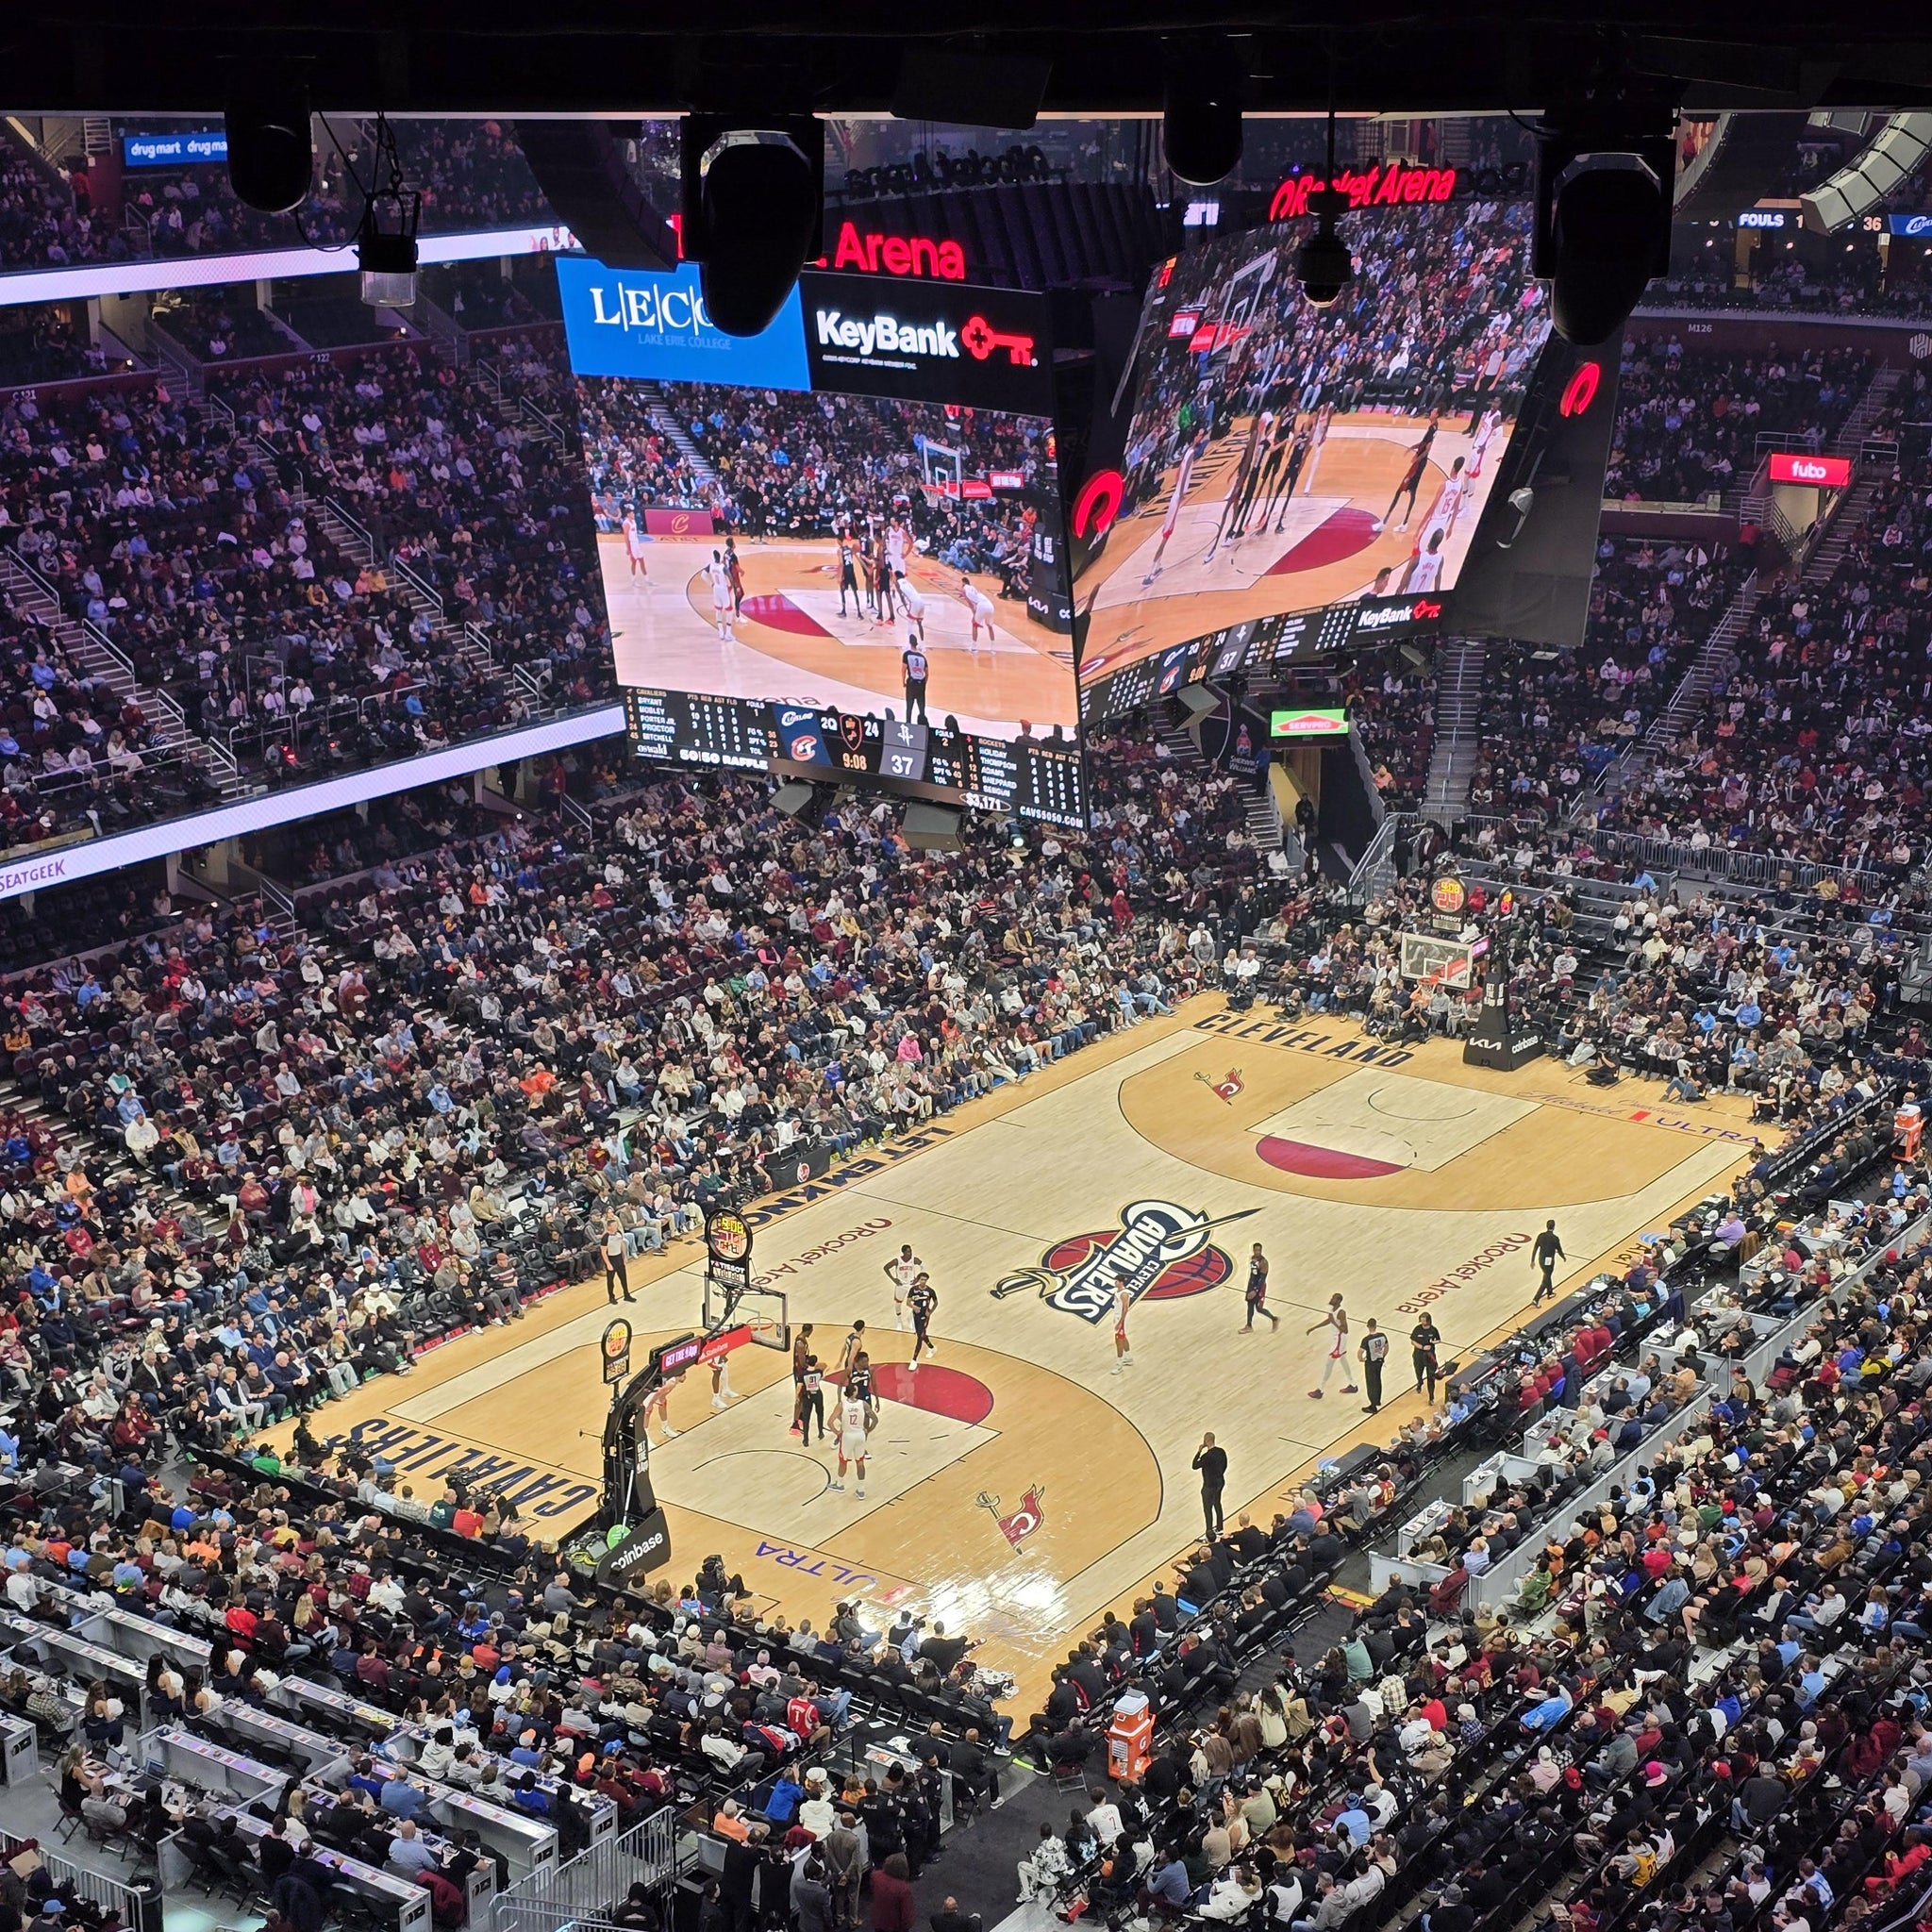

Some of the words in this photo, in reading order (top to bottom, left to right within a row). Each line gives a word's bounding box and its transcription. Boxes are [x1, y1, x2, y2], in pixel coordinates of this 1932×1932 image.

[131, 142, 156, 158] drug
[156, 142, 181, 155] mart
[188, 140, 211, 156] drug
[212, 141, 228, 152] ma
[1290, 165, 1380, 217] Rket
[1374, 163, 1457, 205] Arena
[1740, 213, 1784, 227] FOULS
[1863, 216, 1882, 231] 36
[834, 222, 965, 280] Arena
[638, 333, 661, 345] LAKE
[665, 335, 686, 347] ERIE
[688, 337, 731, 351] COLLEGE
[816, 309, 959, 358] KeyBank
[1791, 460, 1826, 478] fubo
[1358, 605, 1413, 628] KeyBank
[1220, 651, 1238, 670] 37
[864, 721, 879, 738] 24
[722, 755, 769, 771] RAFFLE
[841, 752, 867, 772] 9:08
[891, 754, 914, 775] 37
[965, 791, 1001, 811] $3,171
[1020, 805, 1084, 828] CAVS5050.COM
[0, 859, 66, 892] SEATGEEK
[1437, 892, 1458, 910] 24
[1439, 914, 1462, 924] TISSOT
[1192, 1013, 1415, 1068] CLEVELAND
[1511, 1035, 1539, 1054] coinbase
[1657, 1116, 1761, 1146] ULTRA
[789, 1226, 877, 1266] Rocket
[720, 1262, 746, 1274] TISSOT
[1446, 1241, 1522, 1281] Rocket
[751, 1262, 799, 1286] Are
[1395, 1277, 1462, 1314] Arena
[849, 1413, 858, 1425] 12
[610, 1532, 664, 1570] coinbase
[1108, 1815, 1117, 1831] 7
